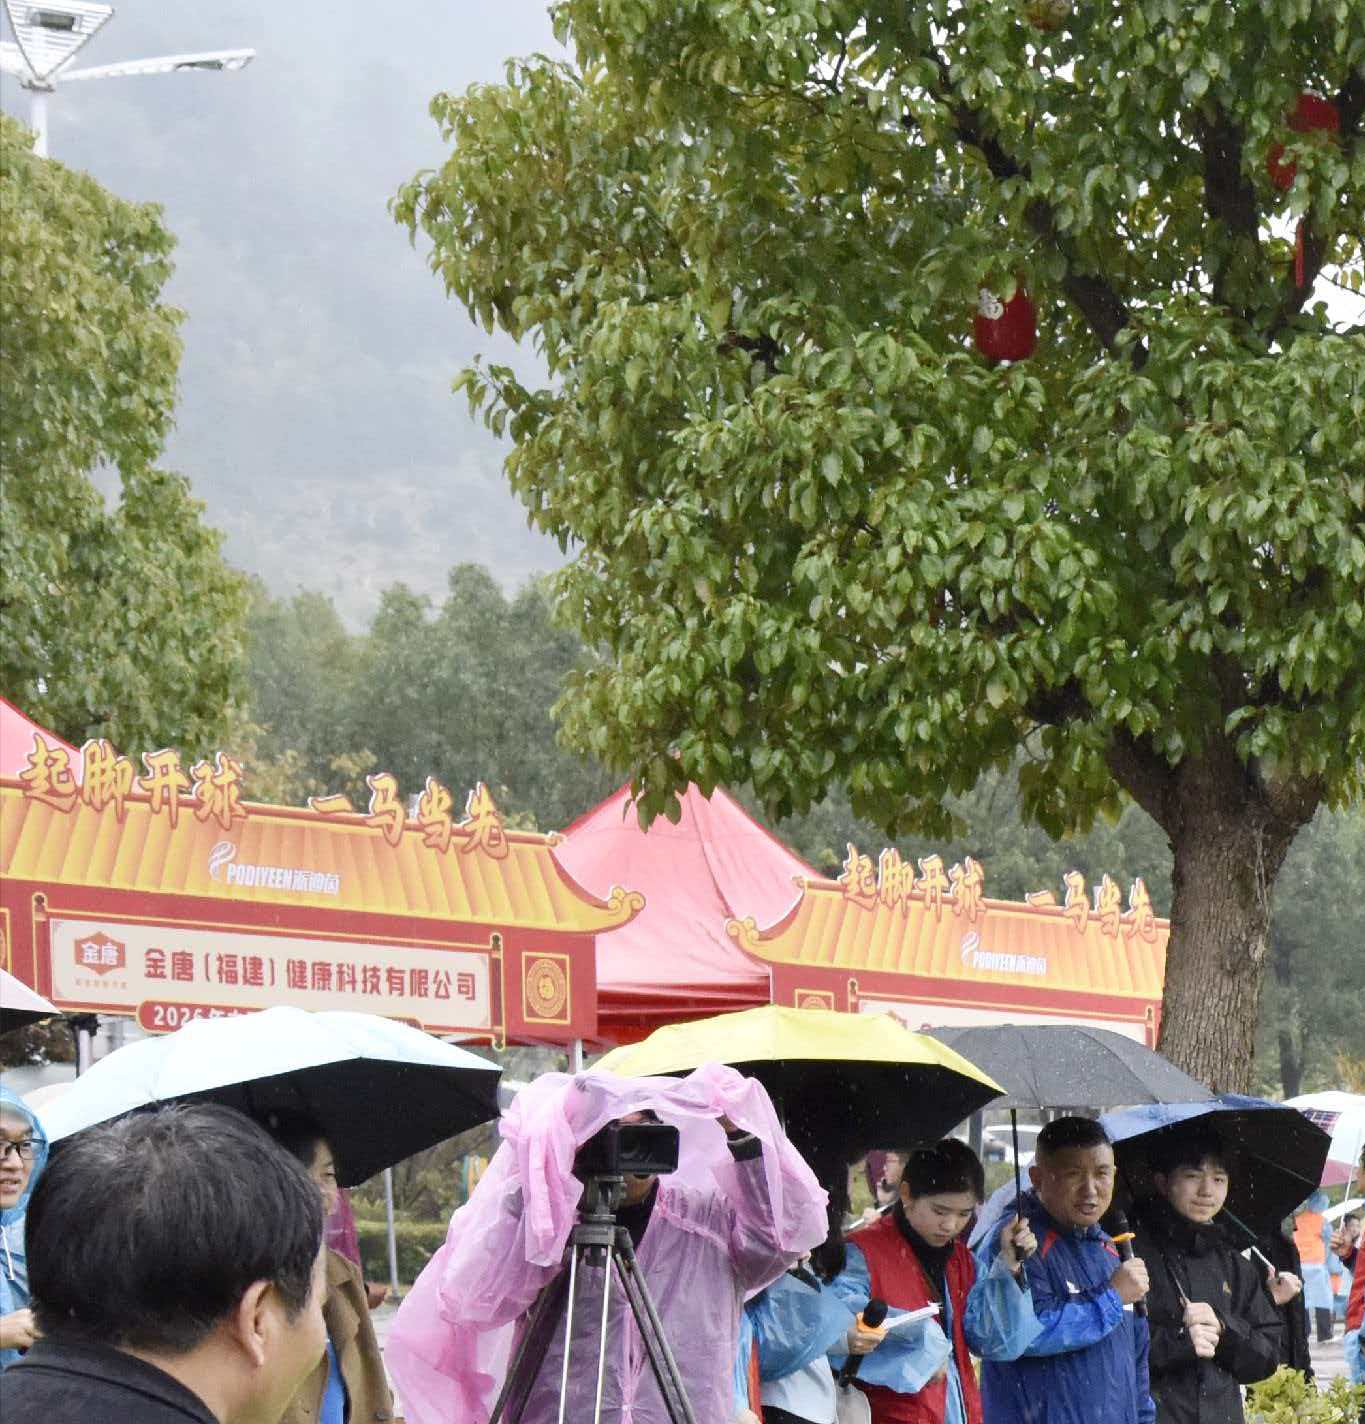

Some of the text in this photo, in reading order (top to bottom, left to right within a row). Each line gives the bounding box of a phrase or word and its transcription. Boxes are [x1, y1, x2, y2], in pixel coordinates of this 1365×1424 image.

[16, 733, 509, 860] 起脚开球 一马当先
[837, 843, 1158, 944] 起脚开球 一马当先
[81, 942, 119, 966] 金唐
[143, 947, 476, 1001] 金唐（福建）健康科技有限公司
